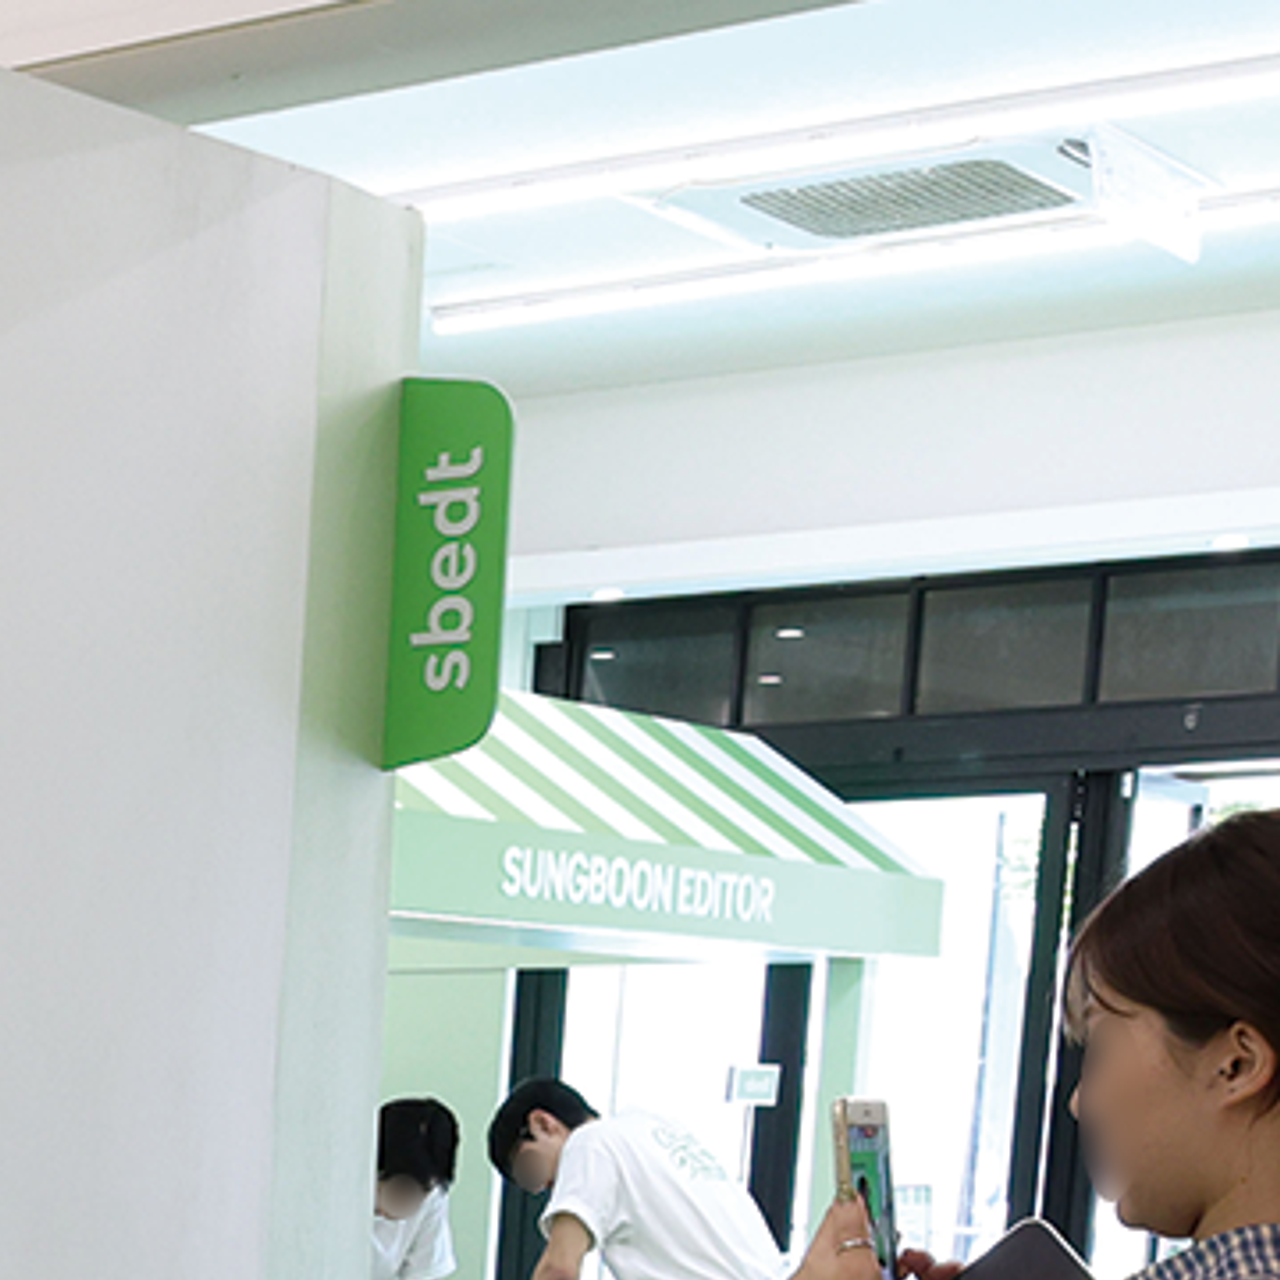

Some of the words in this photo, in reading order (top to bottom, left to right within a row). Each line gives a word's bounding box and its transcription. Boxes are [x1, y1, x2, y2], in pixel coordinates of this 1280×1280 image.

[409, 446, 483, 691] sbedt
[501, 846, 677, 915] SUNGBOON
[679, 868, 776, 923] EDITOR
